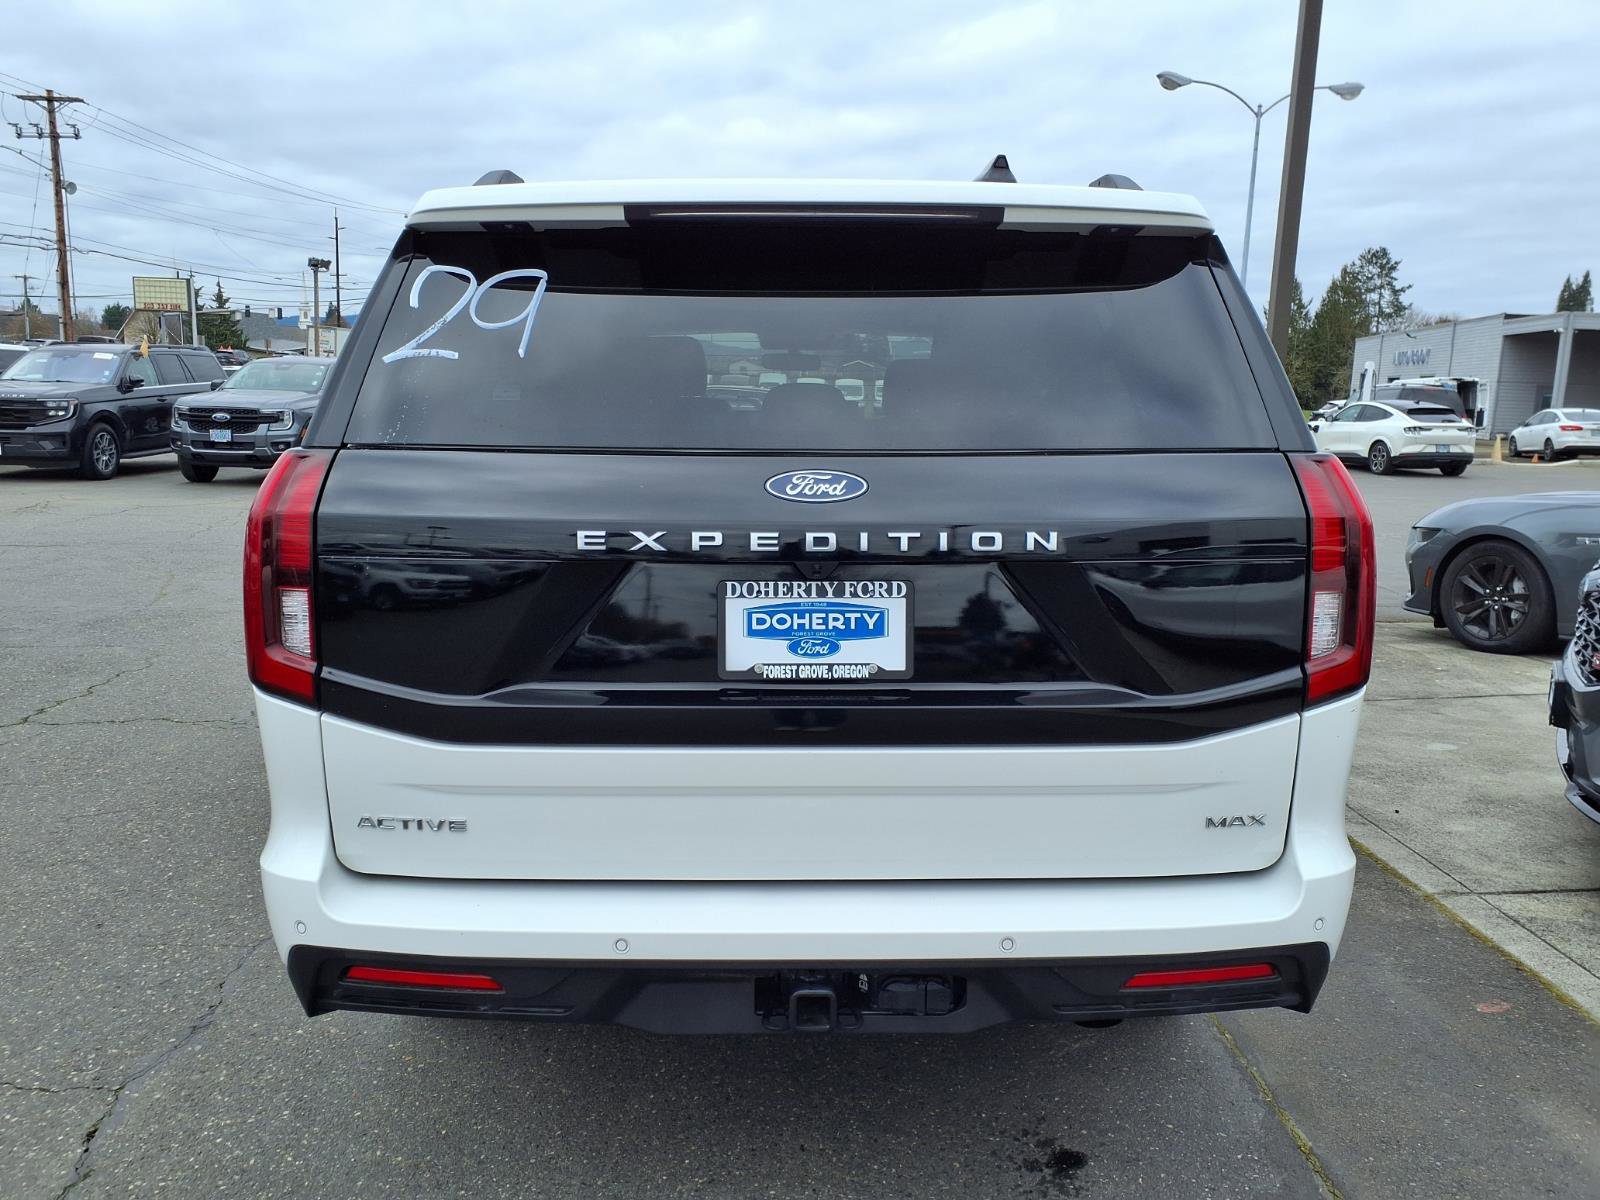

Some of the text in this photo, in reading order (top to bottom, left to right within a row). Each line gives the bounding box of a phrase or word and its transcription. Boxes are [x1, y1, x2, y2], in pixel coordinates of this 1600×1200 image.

[382, 265, 548, 363] 29
[785, 473, 847, 497] Ford
[576, 530, 1059, 552] EXPEDITION
[725, 581, 907, 598] DOHERTY FORD
[751, 613, 881, 630] DOHERTY
[797, 639, 831, 655] Ford
[763, 665, 870, 680] FOREST GROVE, OREGON
[357, 815, 468, 832] ACTIVE
[1205, 813, 1266, 828] MAX
